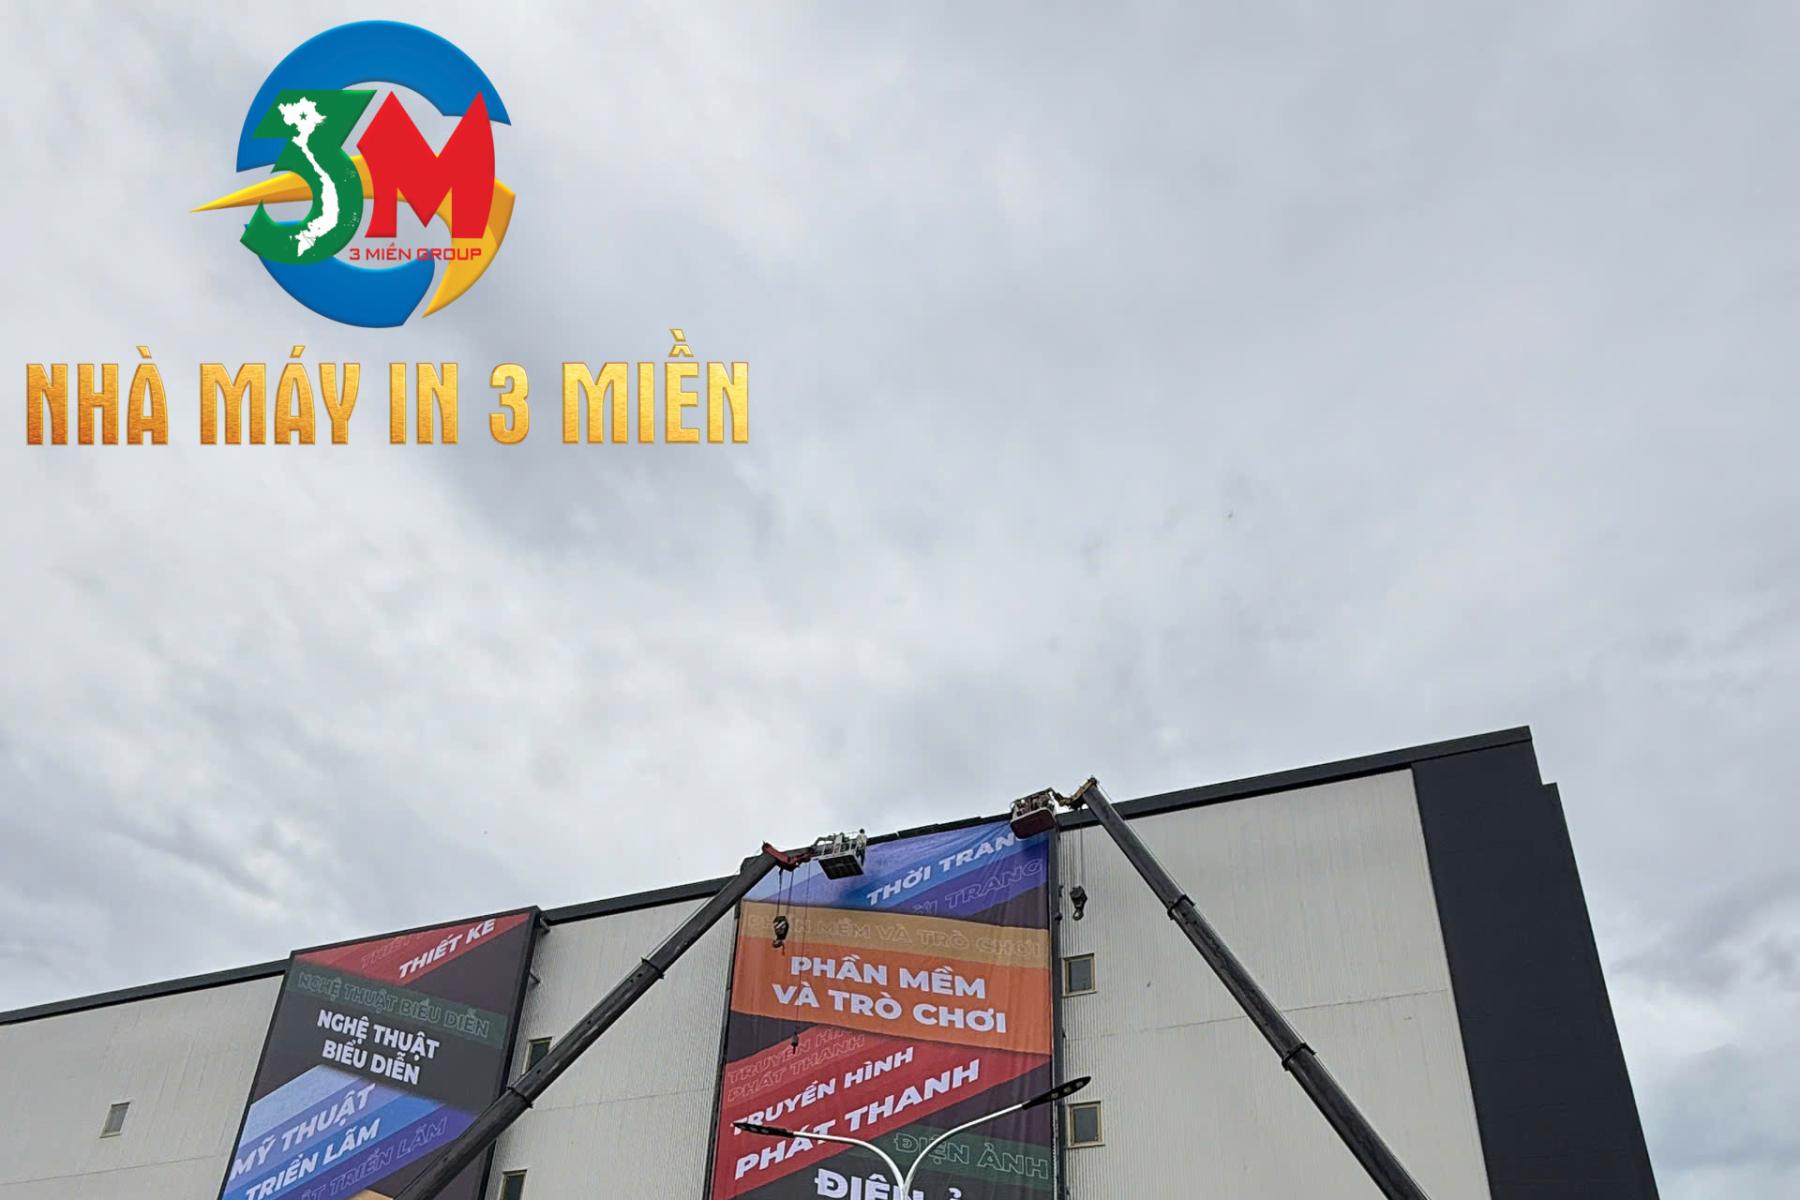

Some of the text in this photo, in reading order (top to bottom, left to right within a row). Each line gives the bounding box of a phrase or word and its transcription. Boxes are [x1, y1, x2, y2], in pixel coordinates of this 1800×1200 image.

[866, 831, 1015, 906] THỜI TRAN
[945, 858, 1043, 910] TRANG
[399, 934, 463, 979] THIẾT
[875, 922, 914, 944] VÀ
[916, 927, 970, 951] TRÒ
[343, 983, 399, 1014] THUẬT
[789, 953, 987, 1000] PHẦN MỀM
[771, 983, 1008, 1034] VÀ TRÒ CHƠI
[316, 1009, 441, 1062] NGHỆ THUẬT
[321, 1038, 422, 1086] BIỂU DIỄN
[726, 1033, 865, 1104] PHÁT THANH
[730, 1046, 916, 1138] TRUYỀN HÌNH
[230, 1083, 377, 1181] MỸ THUẬT
[322, 1118, 382, 1166] LÃM
[734, 1058, 981, 1182] PHÁT THANH
[893, 1132, 1051, 1181] ĐIỆN ẢNH
